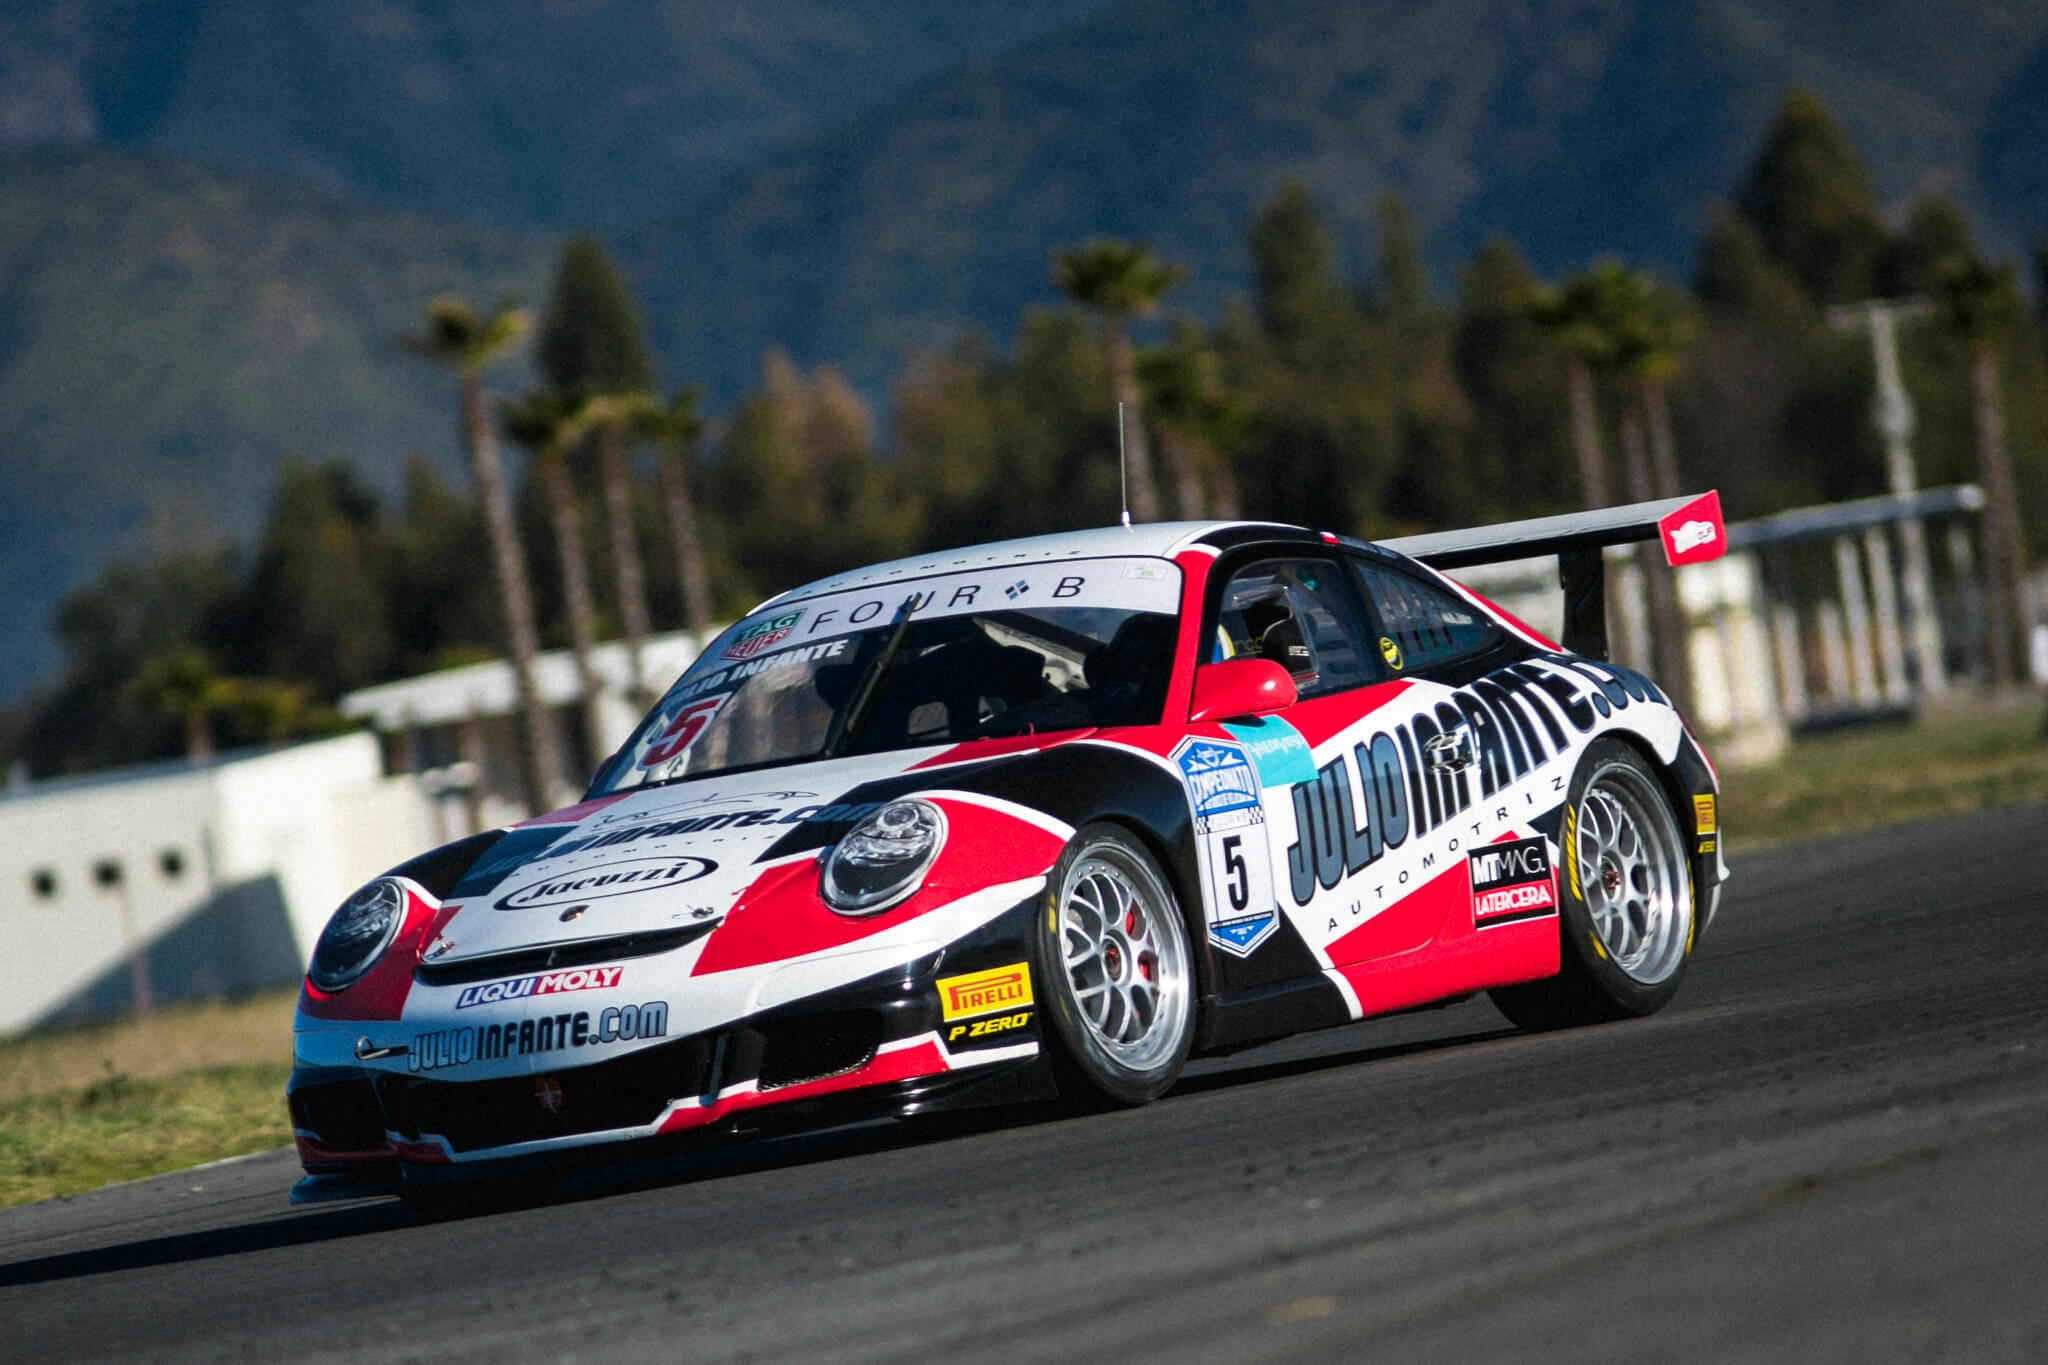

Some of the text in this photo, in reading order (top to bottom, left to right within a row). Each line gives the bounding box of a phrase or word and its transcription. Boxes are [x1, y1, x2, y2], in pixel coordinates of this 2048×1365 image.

[809, 576, 1086, 634] FOUR B
[725, 627, 791, 659] HEUER
[740, 613, 797, 641] TAG
[729, 639, 849, 682] INFANTE
[640, 697, 723, 768] 5
[1222, 834, 1249, 911] 5
[1328, 775, 1566, 932] AUTOMOTRIZ
[516, 862, 689, 903] Jacuzzi
[459, 967, 622, 1008] LIQUI MOLY
[948, 973, 1023, 1011] PIRELLI
[949, 1012, 1029, 1041] P ZERO
